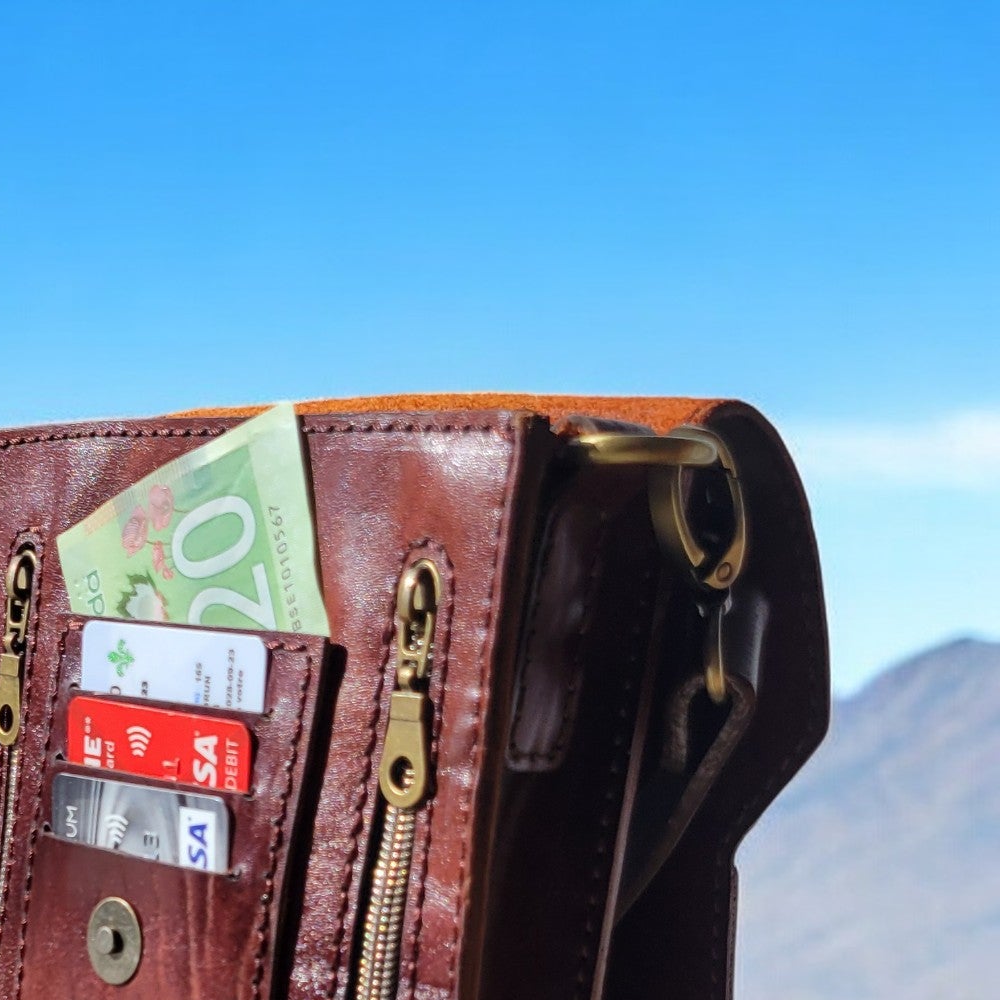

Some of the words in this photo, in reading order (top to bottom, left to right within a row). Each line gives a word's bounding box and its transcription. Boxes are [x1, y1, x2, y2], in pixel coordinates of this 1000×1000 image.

[171, 495, 277, 631] 20
[192, 734, 218, 788] SA
[224, 737, 240, 790] DEBIT
